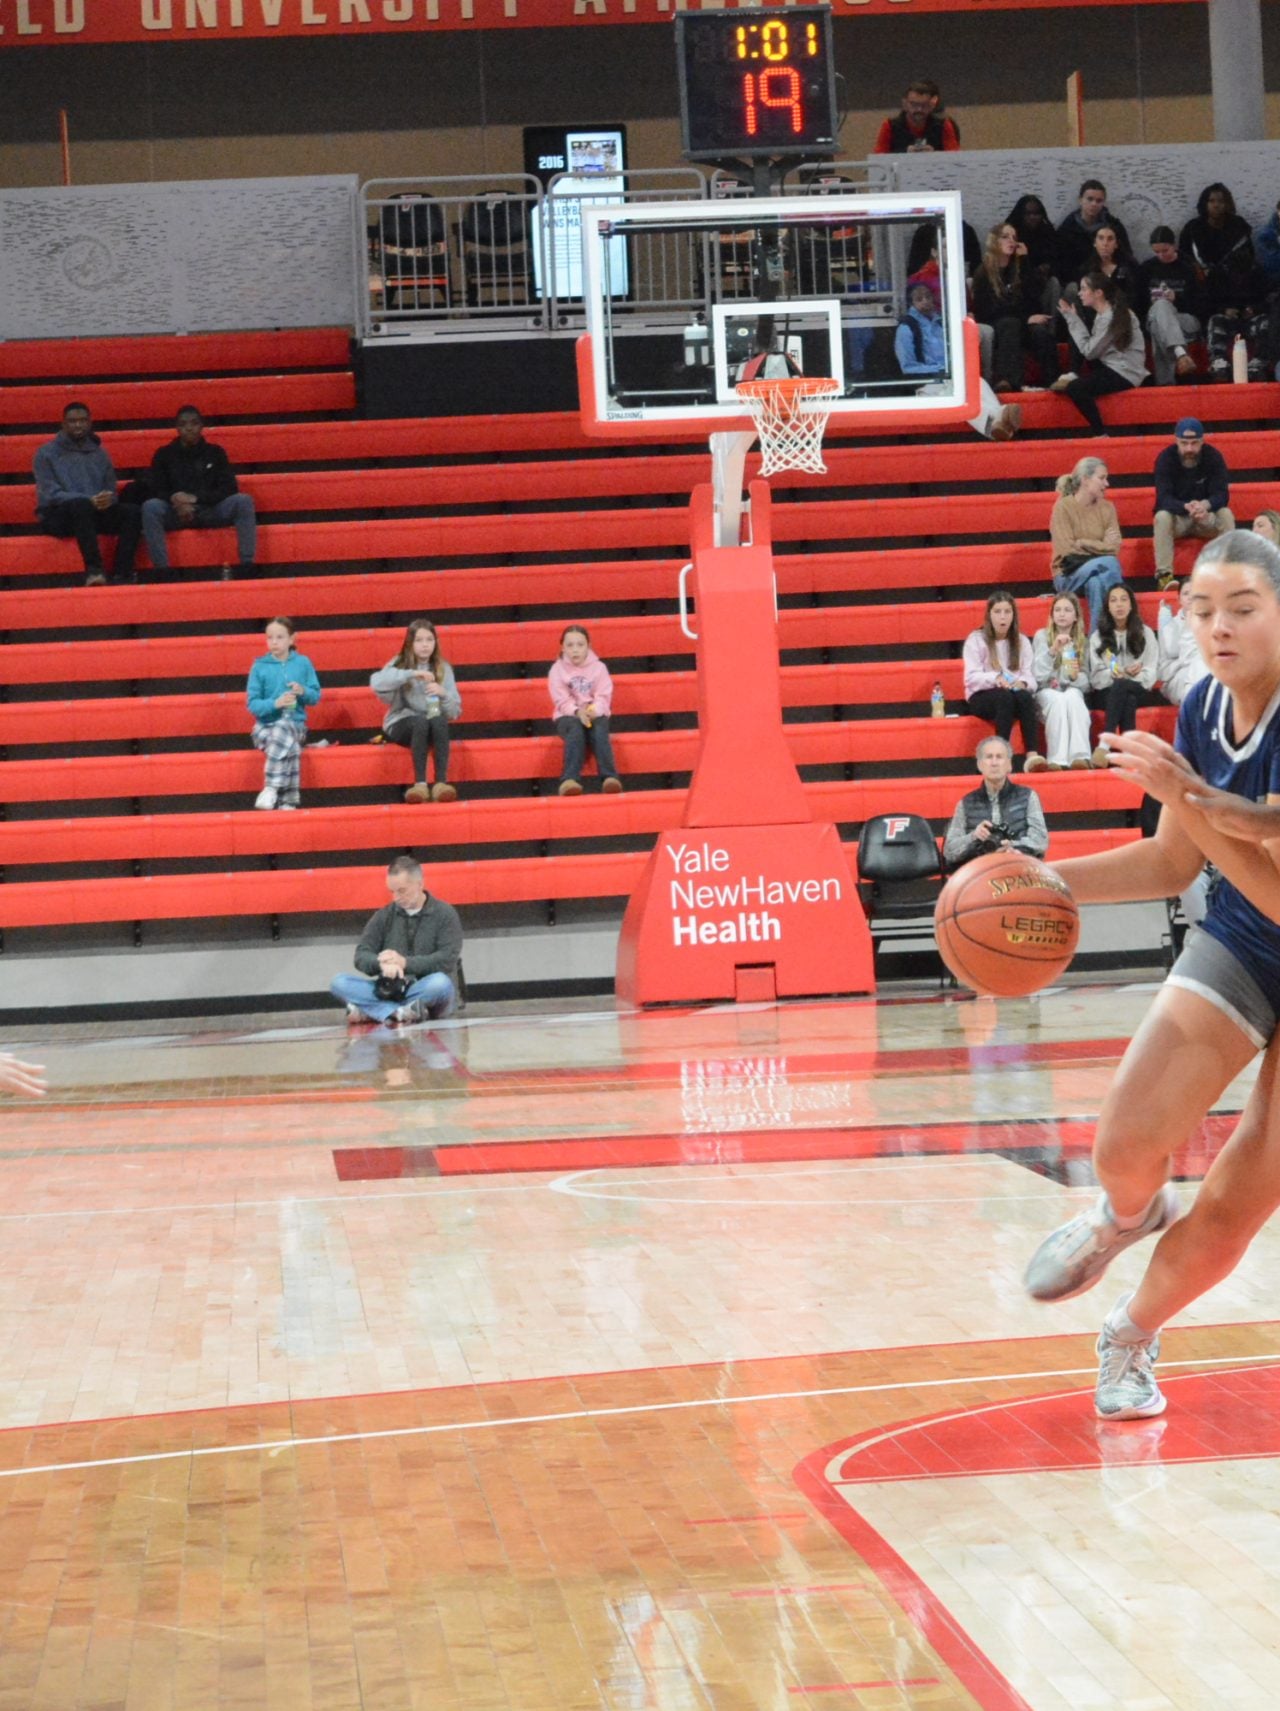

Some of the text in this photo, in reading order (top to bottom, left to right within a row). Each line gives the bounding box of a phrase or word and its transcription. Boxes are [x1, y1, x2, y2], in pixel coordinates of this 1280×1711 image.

[736, 20, 817, 61] 1:01
[744, 67, 801, 135] 19
[883, 817, 910, 839] F
[666, 842, 730, 874] Yale
[670, 875, 842, 910] NewHaven
[988, 872, 1073, 898] SPAL
[672, 911, 782, 946] Health
[1001, 914, 1073, 935] LEGACY
